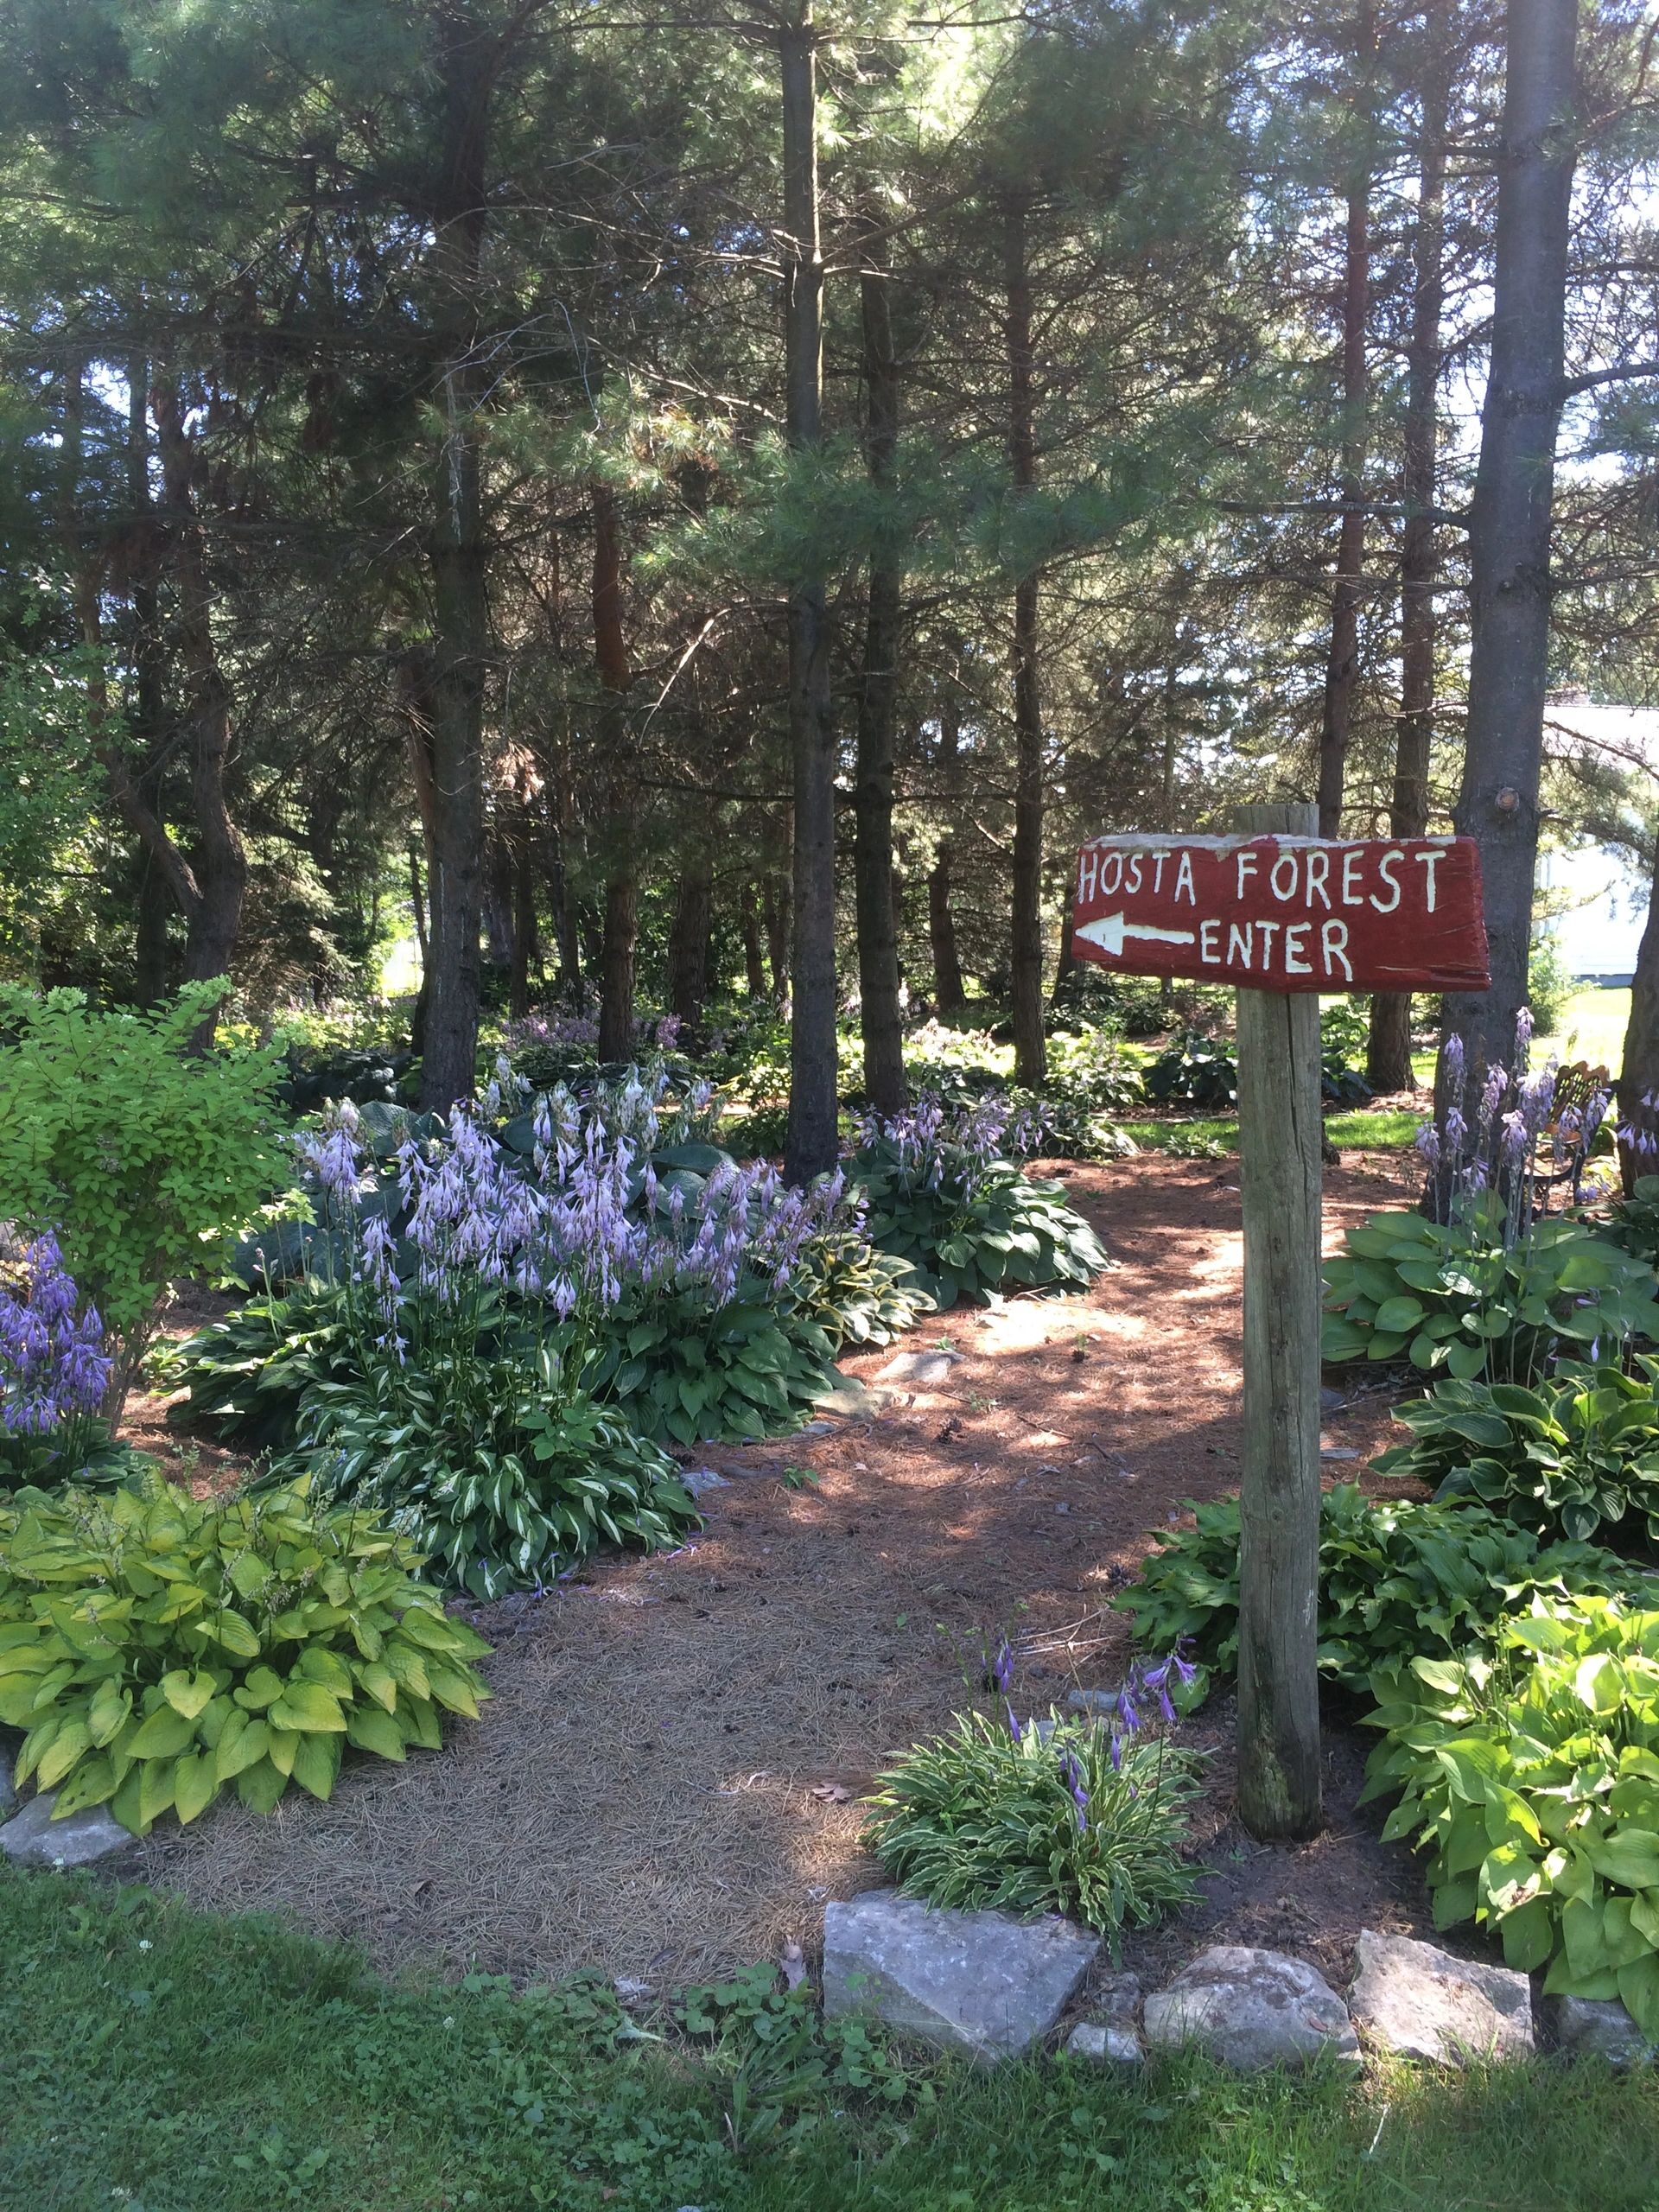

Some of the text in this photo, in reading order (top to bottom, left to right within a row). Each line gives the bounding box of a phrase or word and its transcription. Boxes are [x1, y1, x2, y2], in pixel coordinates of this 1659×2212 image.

[1078, 849, 1446, 913] HOSTA FOREST
[1200, 918, 1353, 982] ENTER
